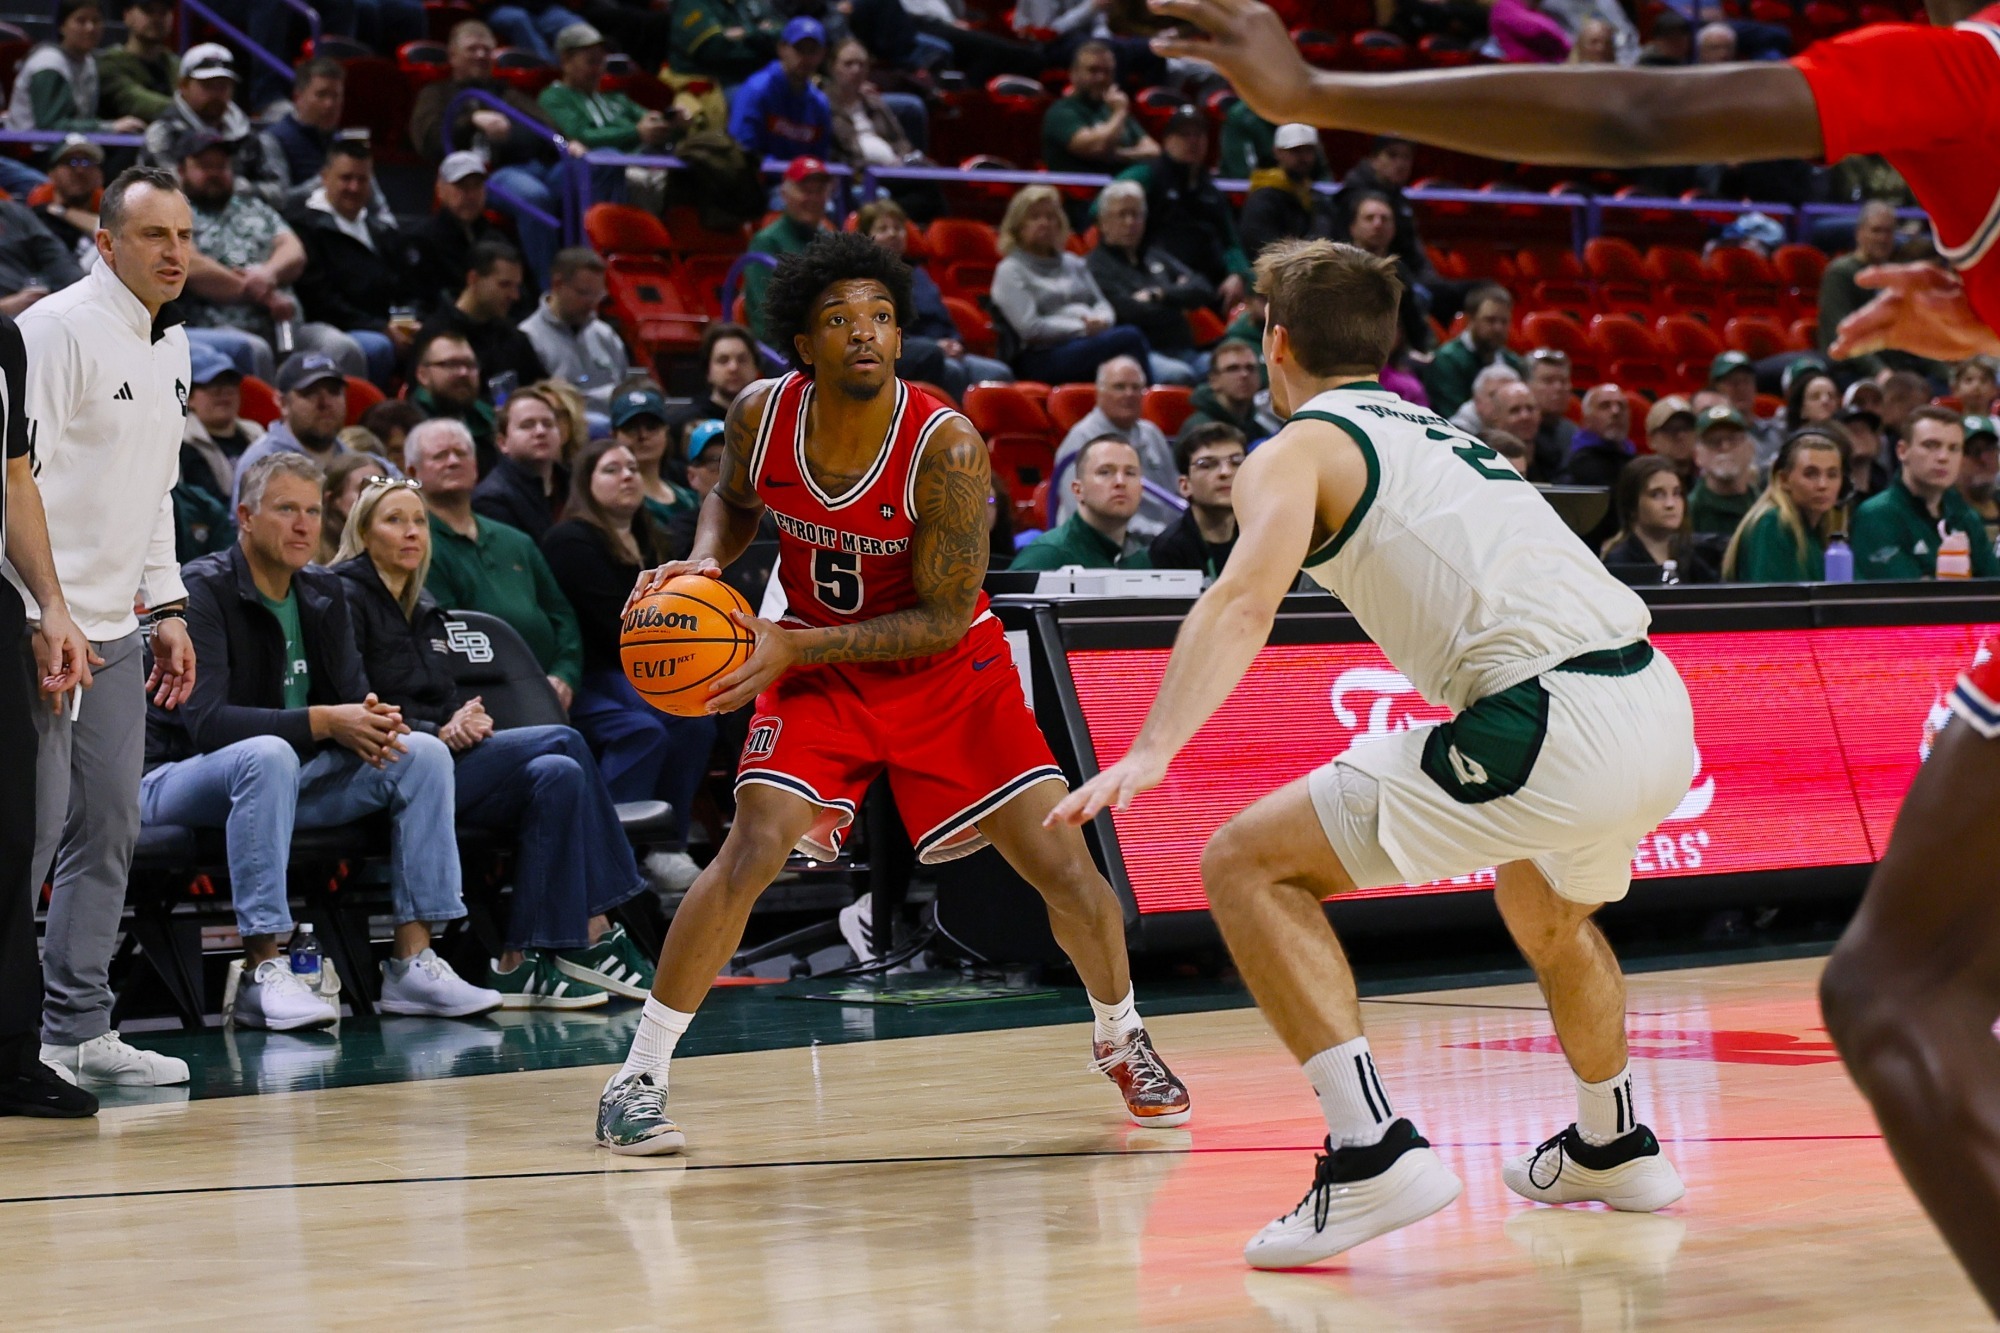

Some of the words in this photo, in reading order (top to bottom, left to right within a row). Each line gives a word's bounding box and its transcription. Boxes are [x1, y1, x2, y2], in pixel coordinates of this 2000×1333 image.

[1426, 428, 1525, 482] 2
[841, 532, 909, 555] MERCY
[810, 548, 865, 615] 5
[623, 605, 698, 635] Wilson
[677, 652, 697, 664] NXT
[1634, 832, 1703, 872] ERS
